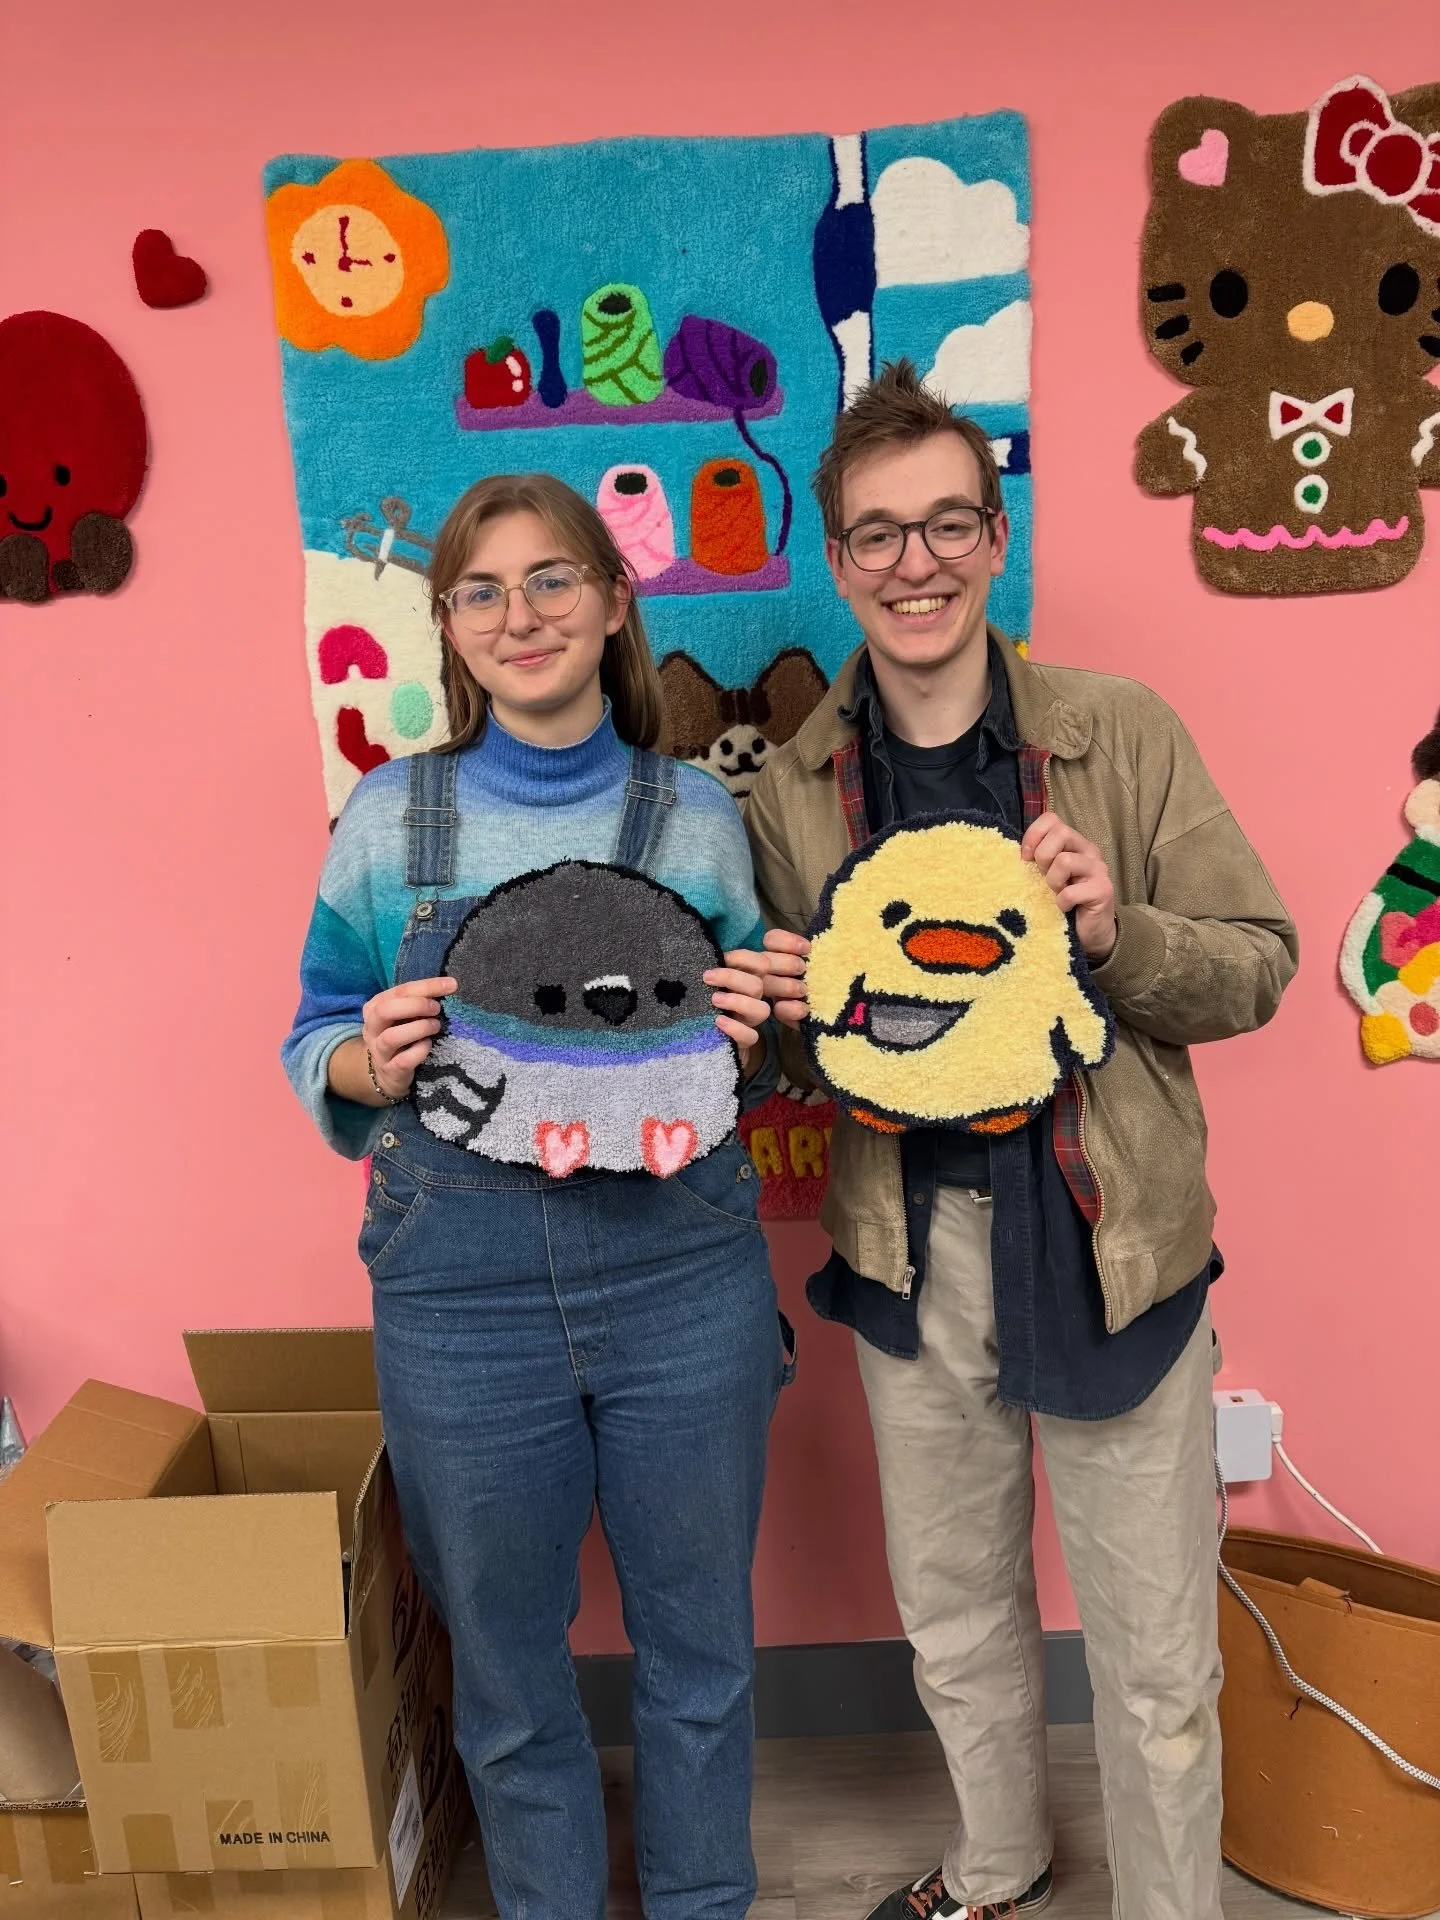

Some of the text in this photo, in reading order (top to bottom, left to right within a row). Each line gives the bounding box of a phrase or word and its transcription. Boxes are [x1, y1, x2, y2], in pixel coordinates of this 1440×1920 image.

[750, 1125, 832, 1178] AR
[219, 1831, 331, 1845] MADE IN CHINA
